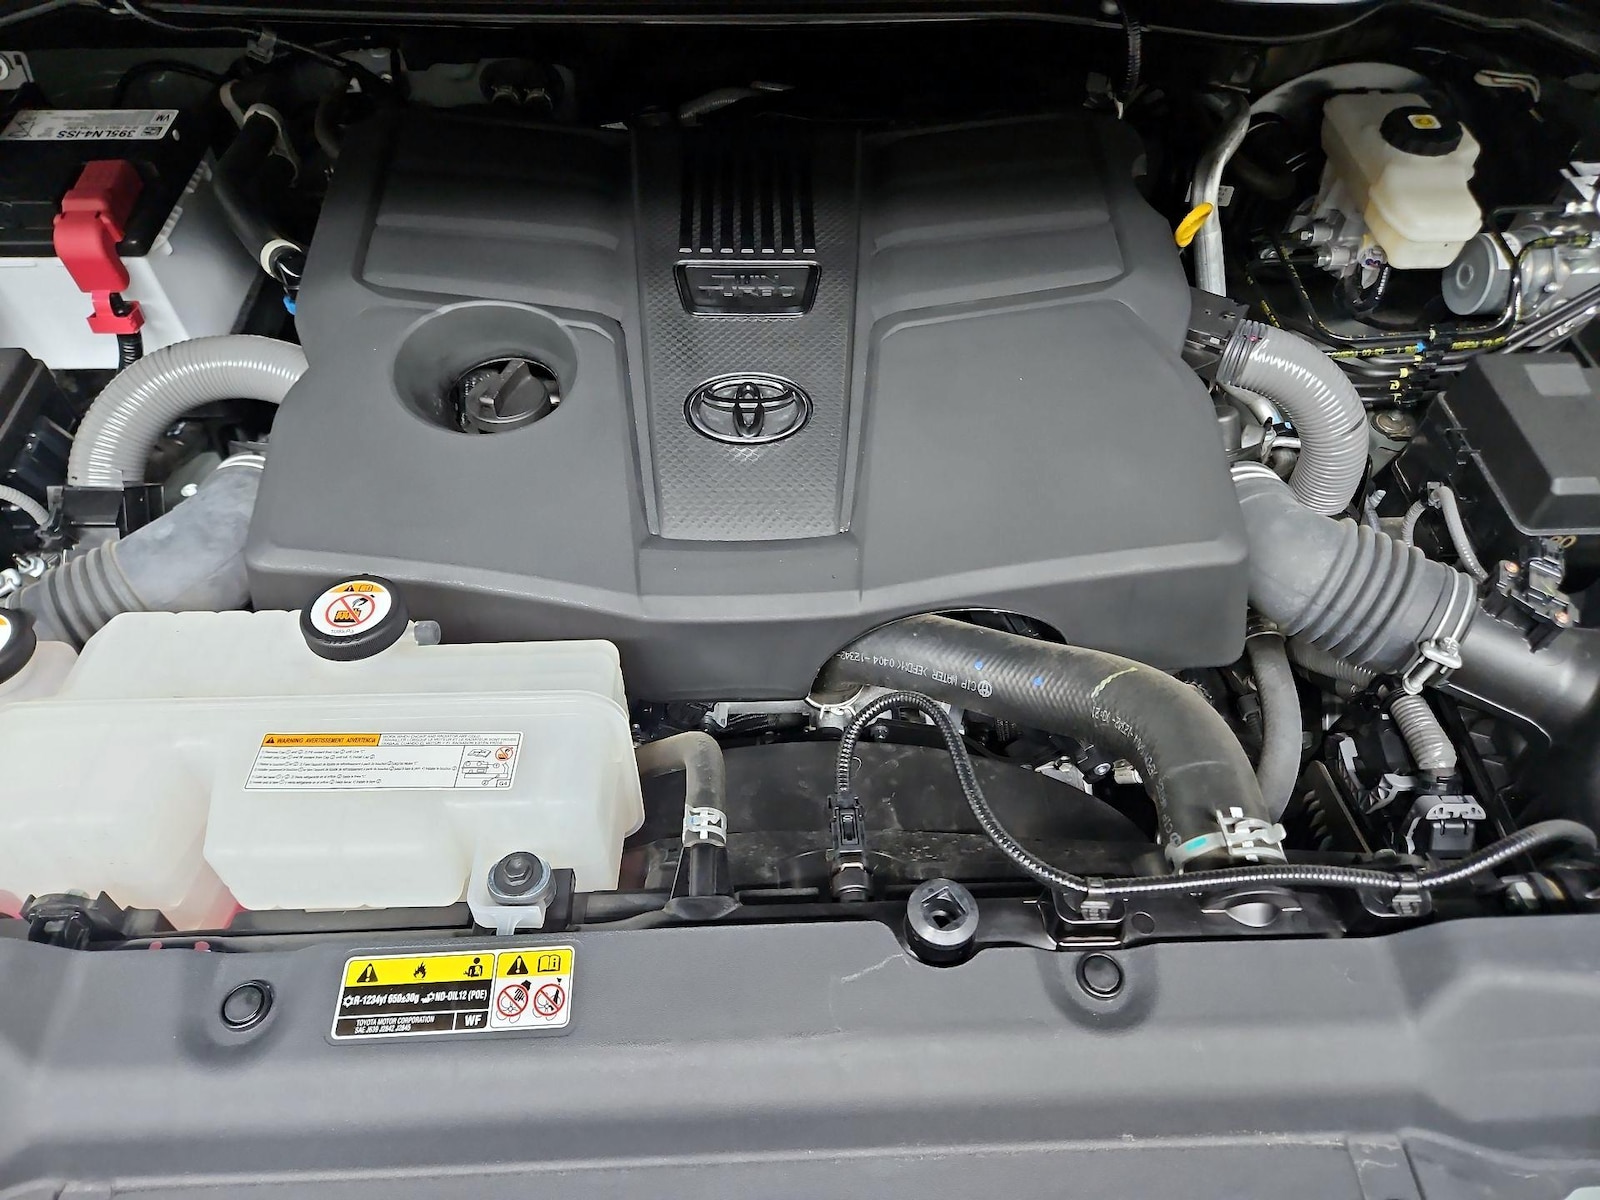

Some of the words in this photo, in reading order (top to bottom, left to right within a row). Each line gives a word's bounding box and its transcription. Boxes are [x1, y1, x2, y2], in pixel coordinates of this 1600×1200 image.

[56, 130, 136, 138] 395LN4-ISS
[960, 680, 977, 692] CIP
[353, 993, 388, 1006] R-1234yf
[388, 992, 420, 1005] 650±30g
[468, 989, 487, 1002] (POE)
[356, 1018, 377, 1026] TOYOTA
[377, 1017, 397, 1025] MOTOR
[397, 1015, 435, 1024] CORPORATION
[464, 1014, 482, 1027] WF
[354, 1026, 366, 1034] SAE
